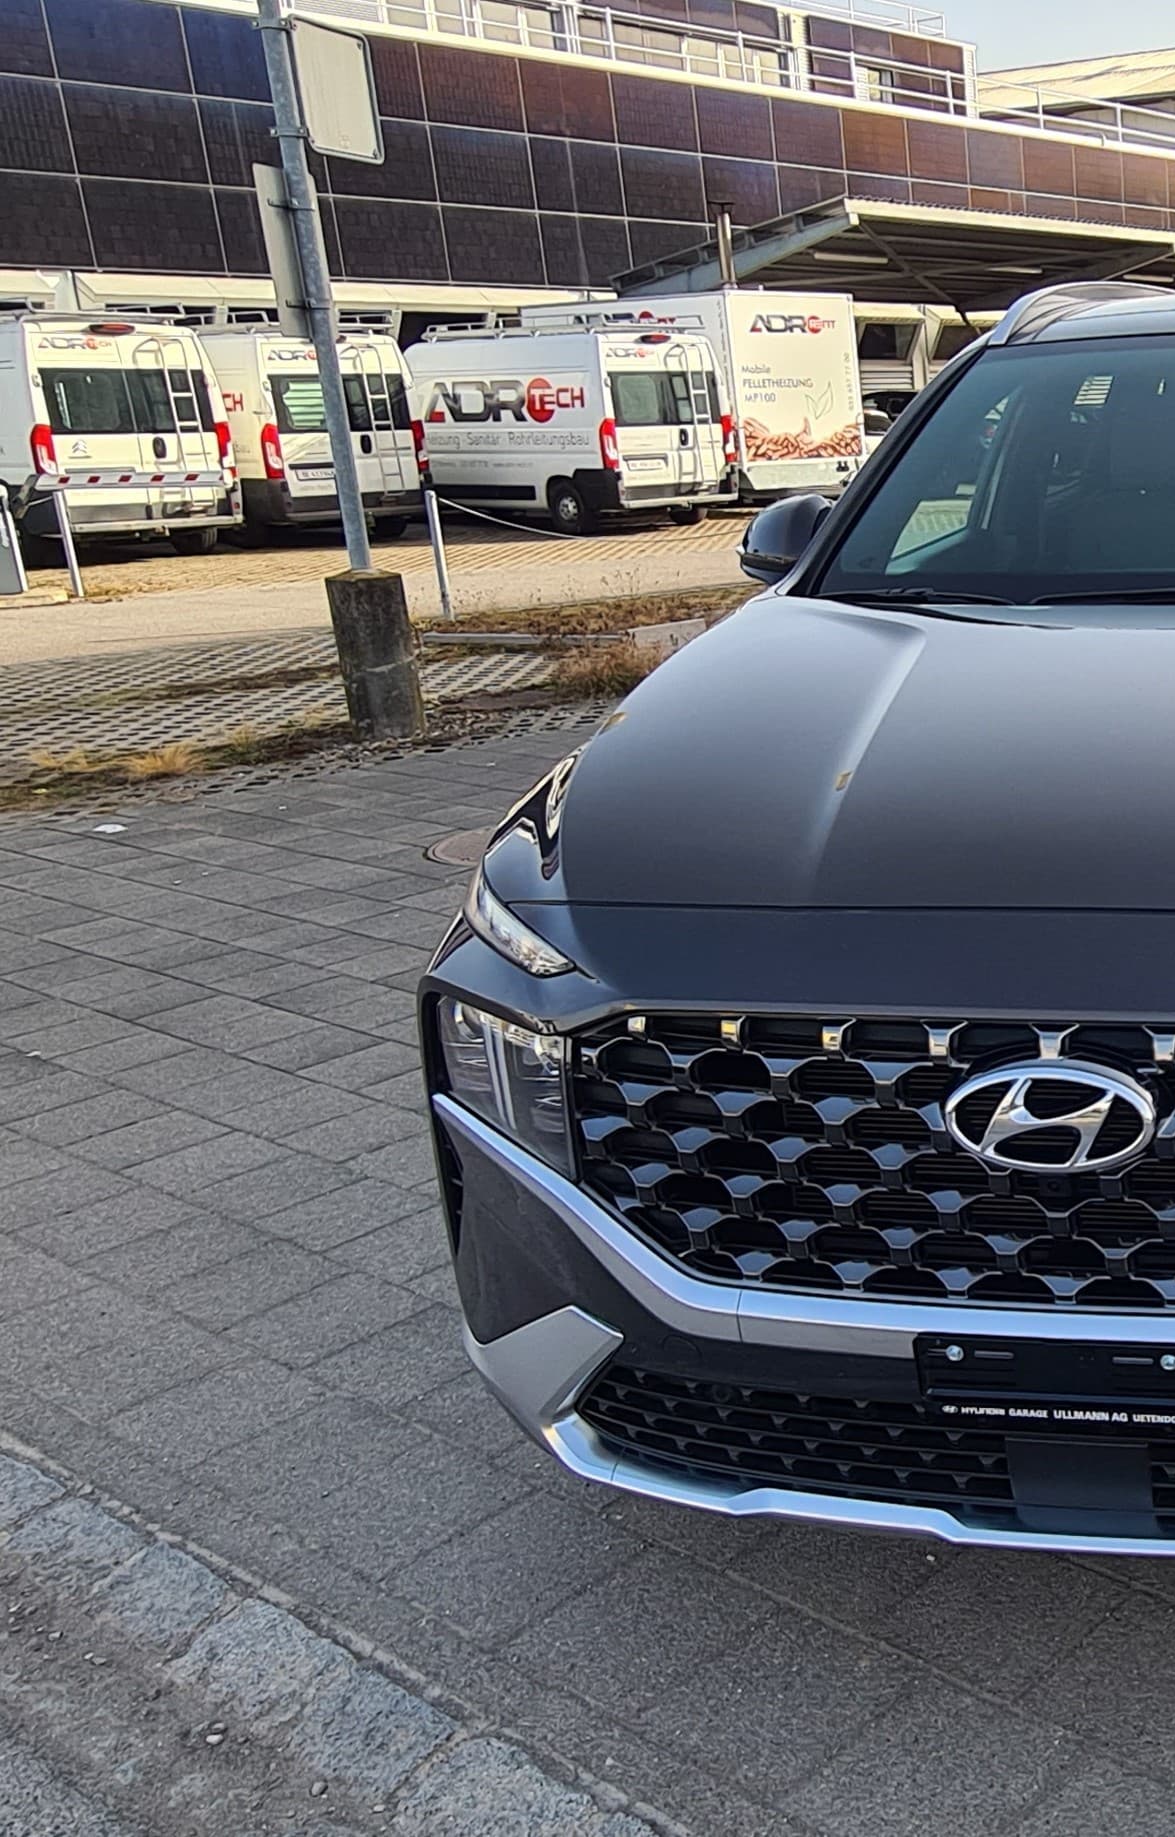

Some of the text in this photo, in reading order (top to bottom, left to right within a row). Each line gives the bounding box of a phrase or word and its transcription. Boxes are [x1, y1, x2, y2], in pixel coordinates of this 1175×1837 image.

[742, 363, 771, 374] Mobile
[427, 431, 460, 449] eizung
[508, 431, 590, 449] Rohrleitungsbau
[1008, 1407, 1049, 1418] GARAGE
[1053, 1409, 1110, 1421] ULLMANN
[1111, 1411, 1128, 1422] AG
